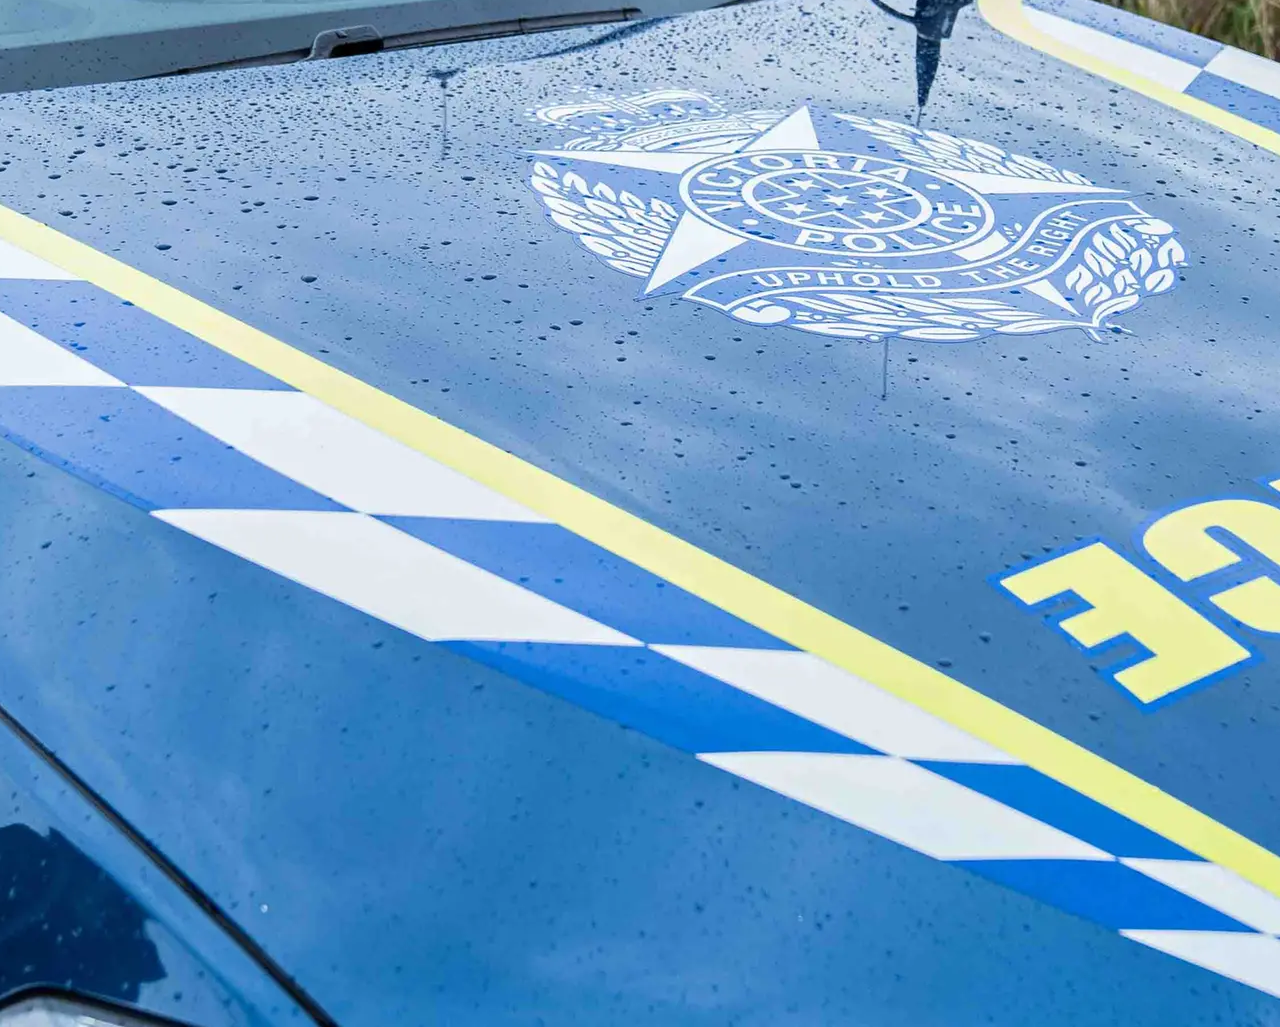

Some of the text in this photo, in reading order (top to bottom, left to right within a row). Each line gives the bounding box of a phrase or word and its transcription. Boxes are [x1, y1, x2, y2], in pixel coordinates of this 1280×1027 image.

[692, 154, 911, 214] VICTORIA
[751, 210, 1089, 290] UPHOLD THE RIGHT
[793, 200, 982, 253] POLICE
